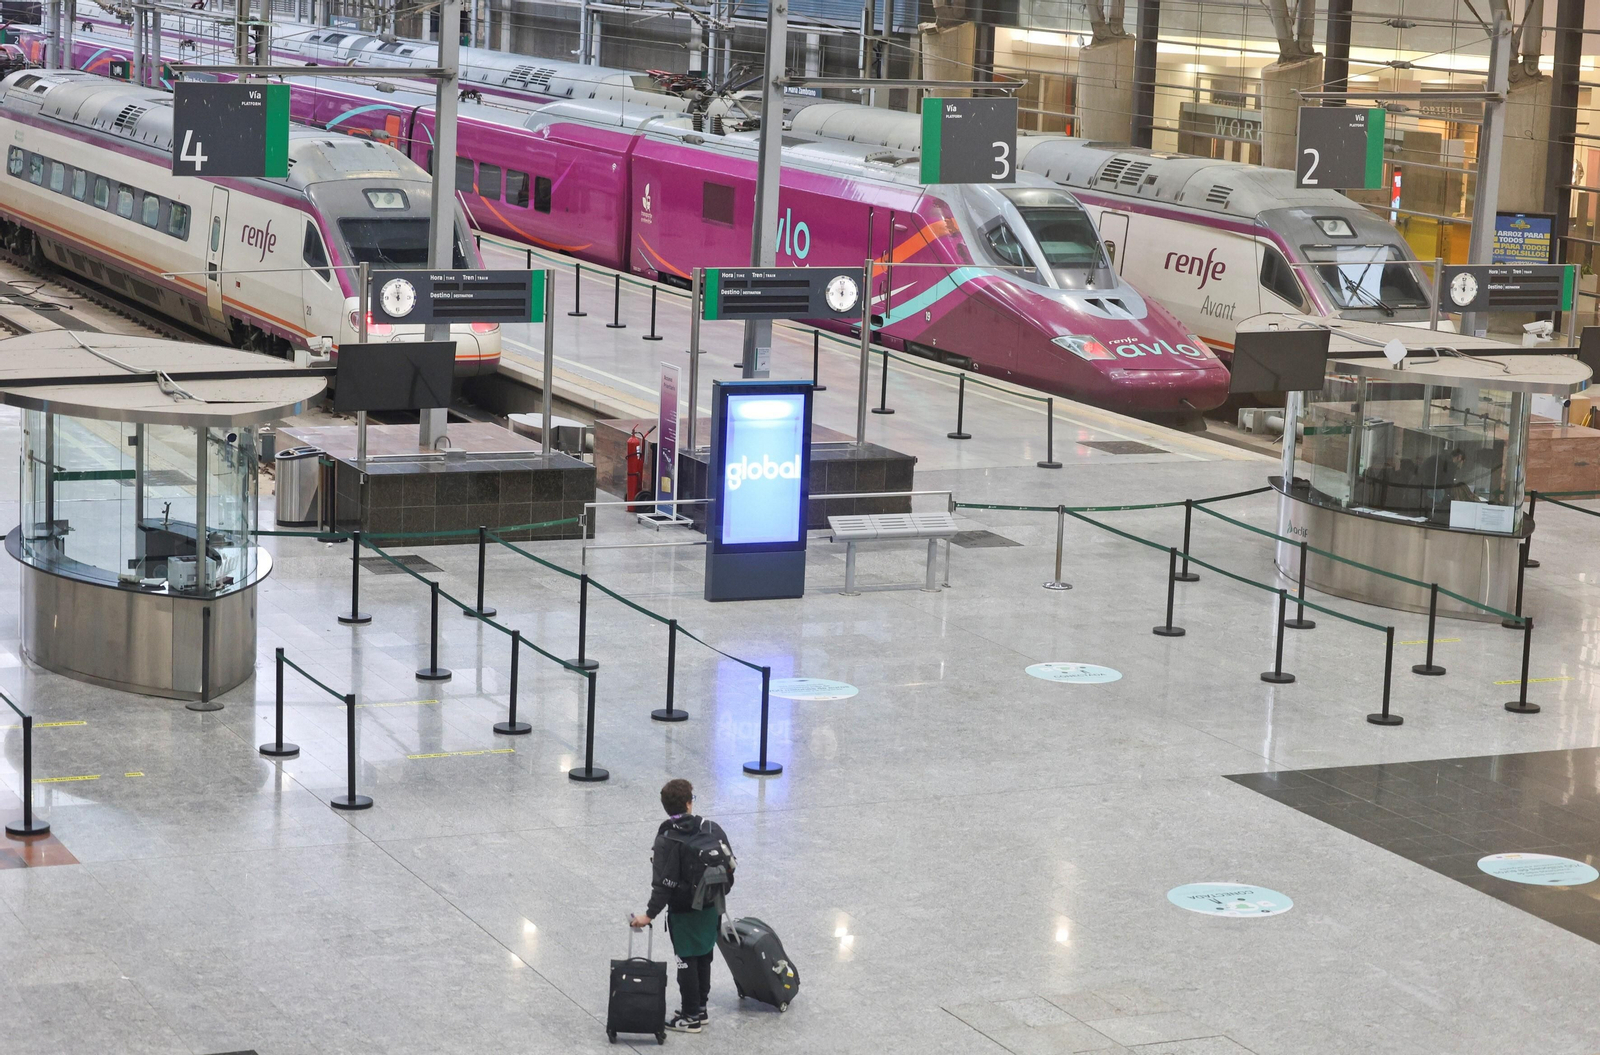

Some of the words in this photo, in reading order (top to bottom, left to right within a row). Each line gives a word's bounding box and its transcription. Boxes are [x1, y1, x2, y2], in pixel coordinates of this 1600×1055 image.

[249, 90, 261, 99] Vía
[946, 104, 957, 112] Vía
[180, 130, 208, 171] 4
[991, 141, 1010, 180] 3
[1302, 148, 1320, 184] 2
[241, 219, 276, 263] renfe
[1164, 248, 1226, 290] renfe
[925, 311, 931, 321] 19
[1200, 295, 1236, 321] Avant
[1116, 340, 1200, 358] avlo
[727, 454, 800, 491] global
